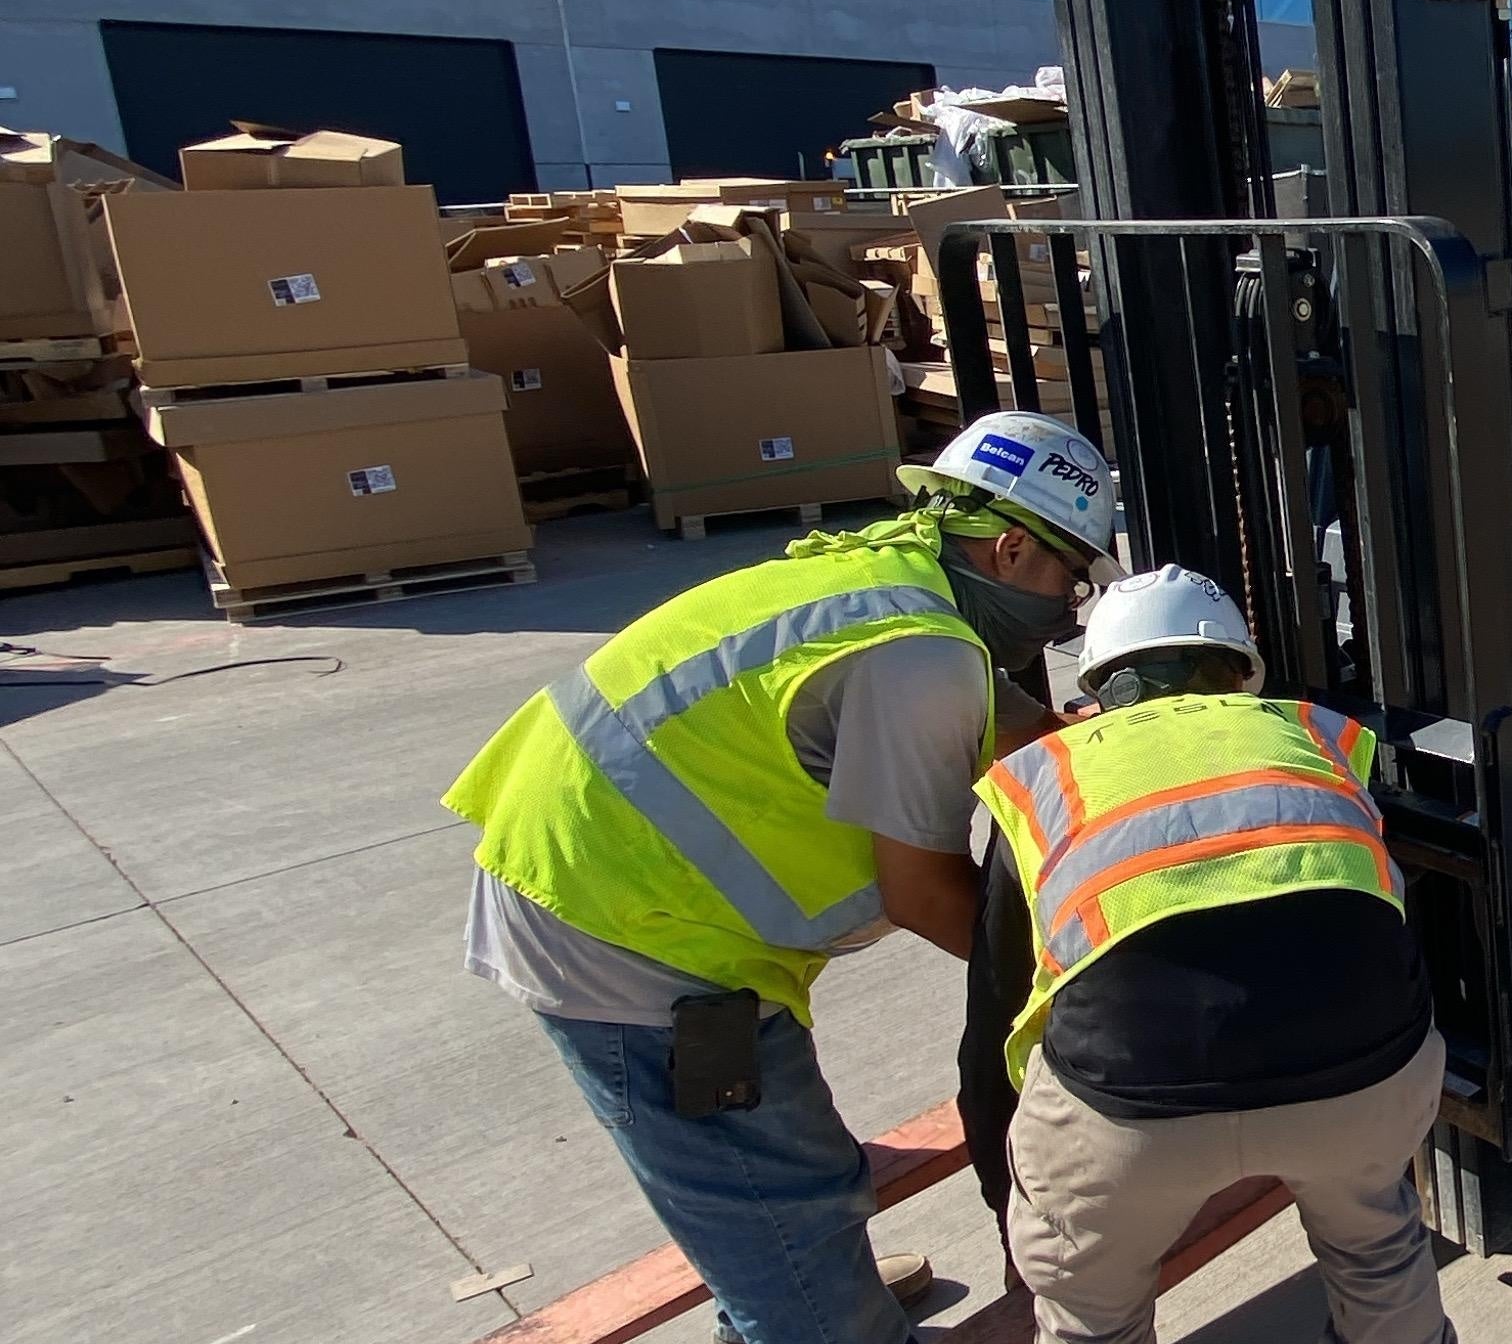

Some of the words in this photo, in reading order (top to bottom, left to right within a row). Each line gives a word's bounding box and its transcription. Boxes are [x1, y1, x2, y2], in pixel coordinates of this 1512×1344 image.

[979, 441, 1025, 467] Belcan
[1038, 452, 1099, 497] PEDRO
[1086, 697, 1290, 744] TESLA
